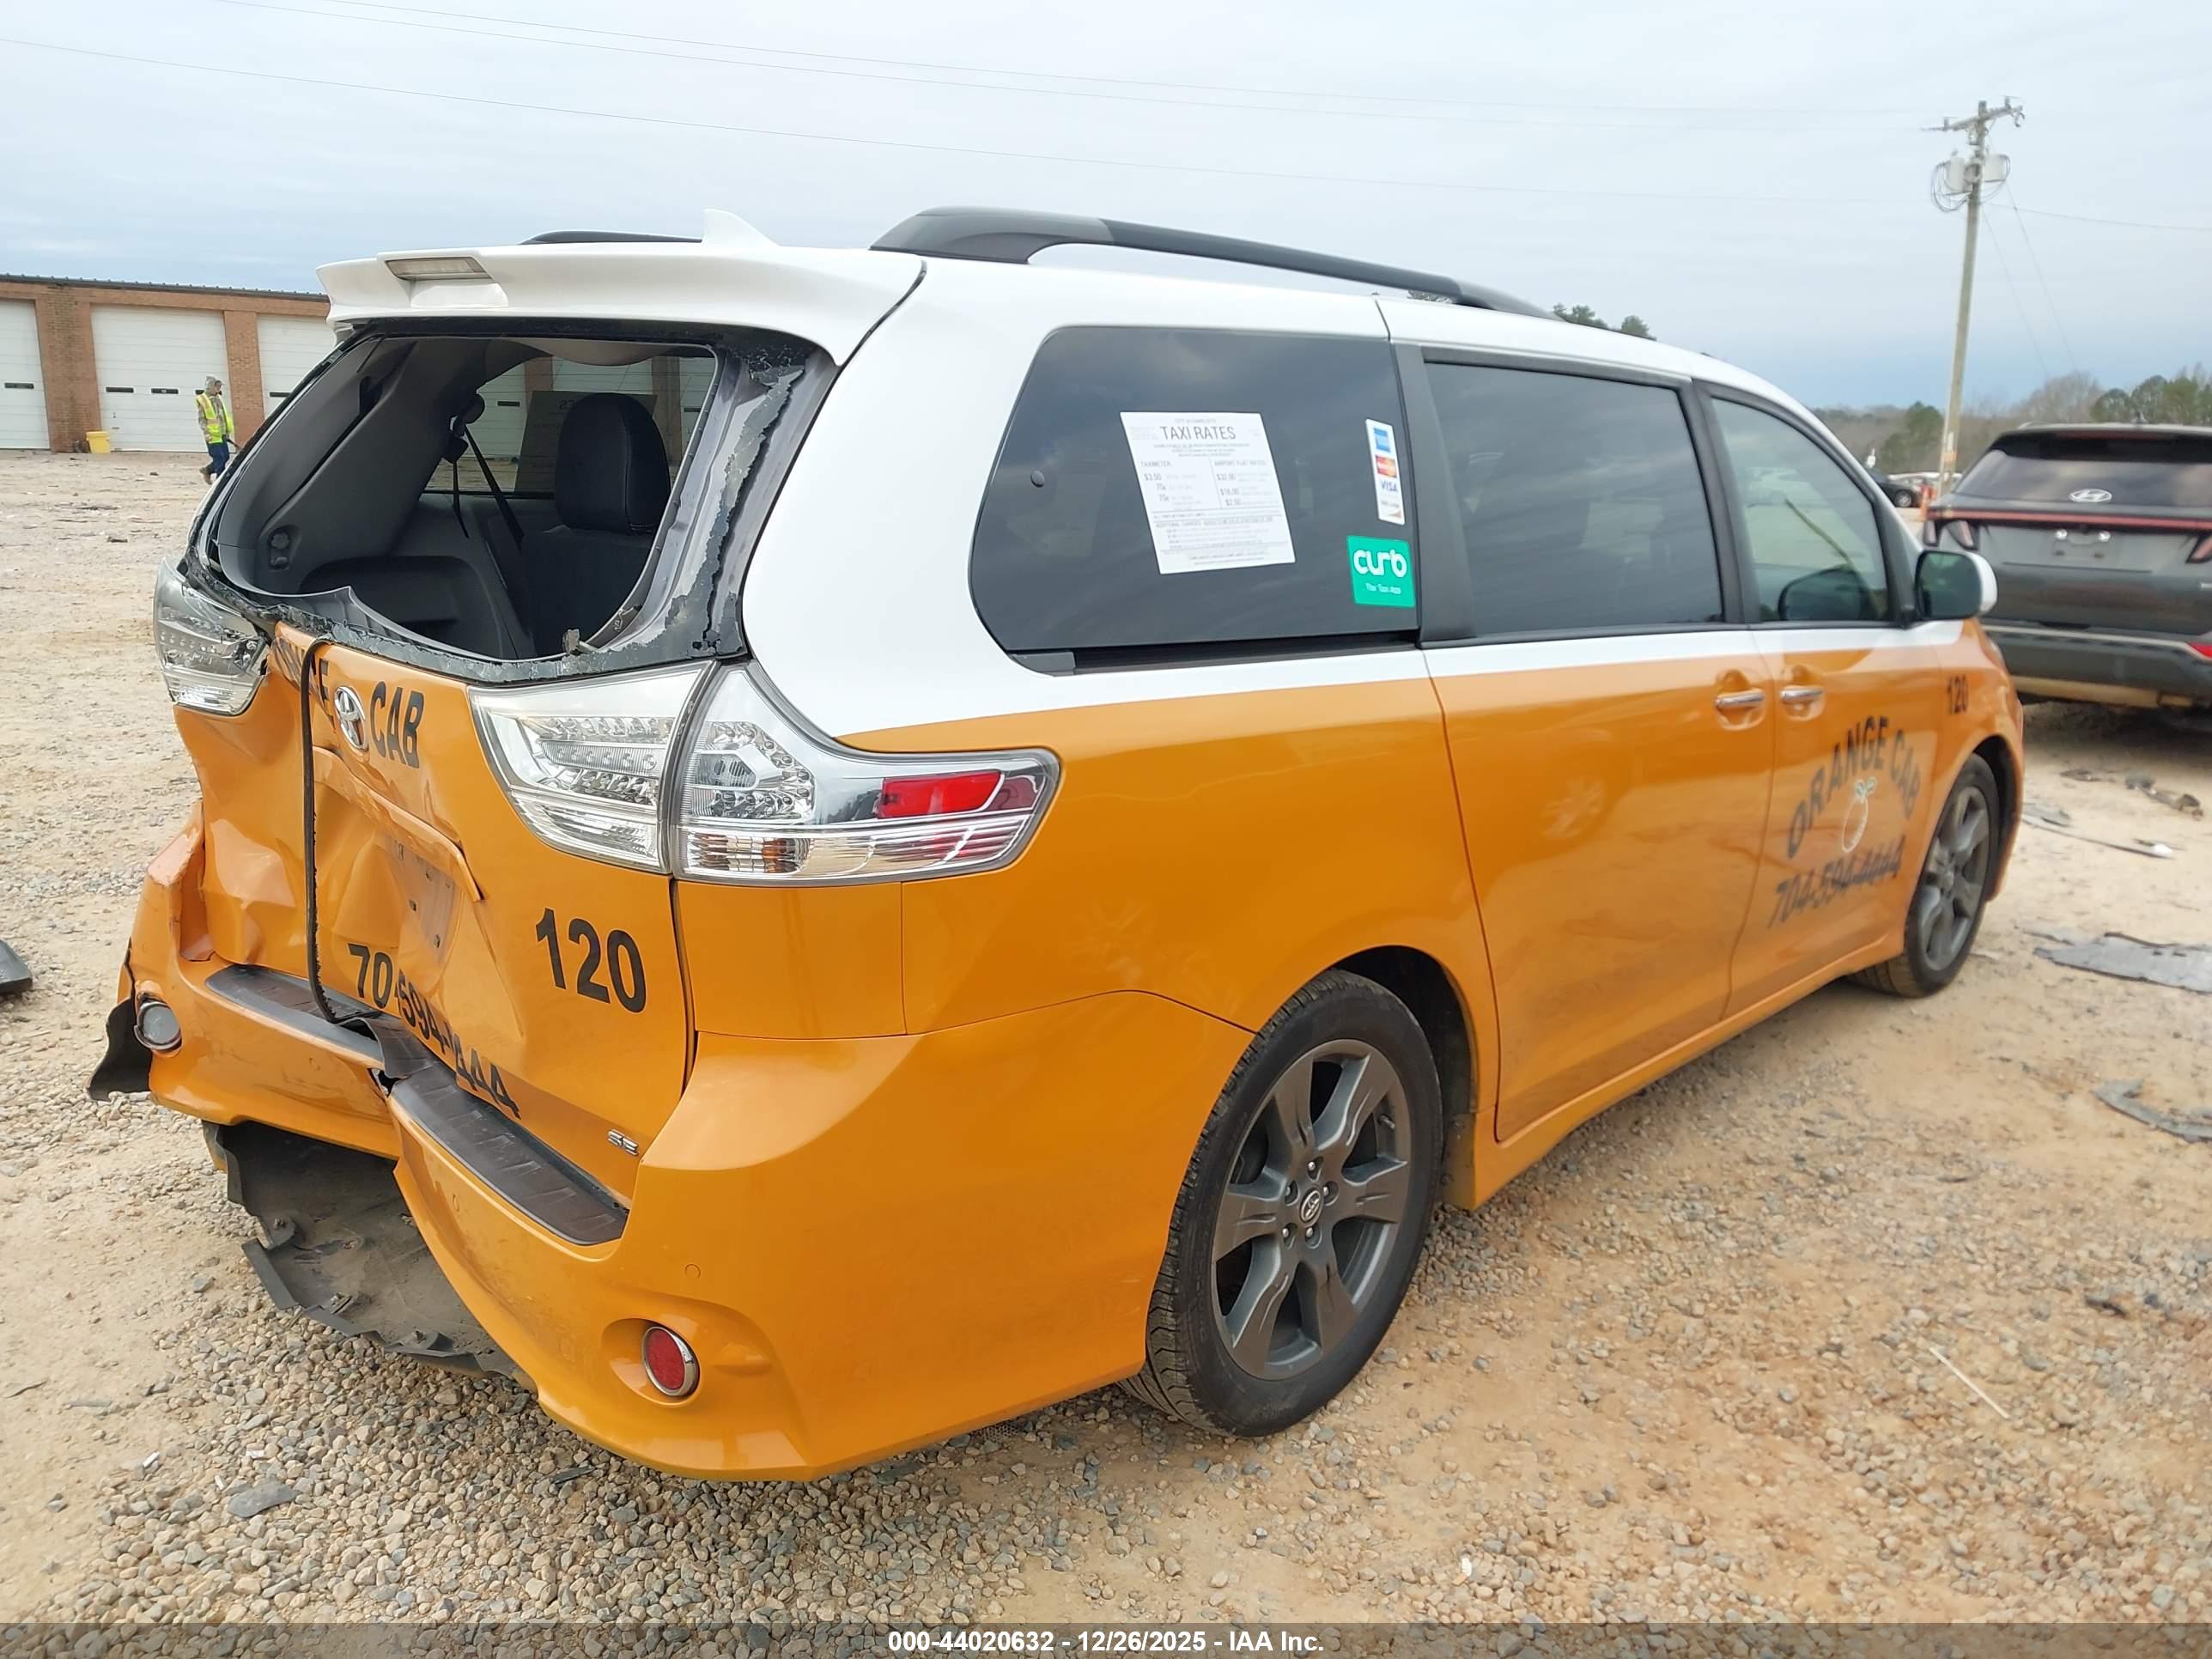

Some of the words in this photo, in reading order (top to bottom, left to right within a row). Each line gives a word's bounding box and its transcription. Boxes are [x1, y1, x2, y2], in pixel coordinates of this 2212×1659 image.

[1159, 426, 1192, 440] TAXI
[1194, 426, 1236, 440] RATES
[1381, 481, 1399, 493] VISA
[1352, 549, 1407, 578] curb
[1946, 673, 1970, 715] 120
[369, 680, 425, 769] CAB
[1788, 714, 1889, 859] ORANGE
[1890, 729, 1921, 821] CAB
[535, 907, 646, 1013] 120
